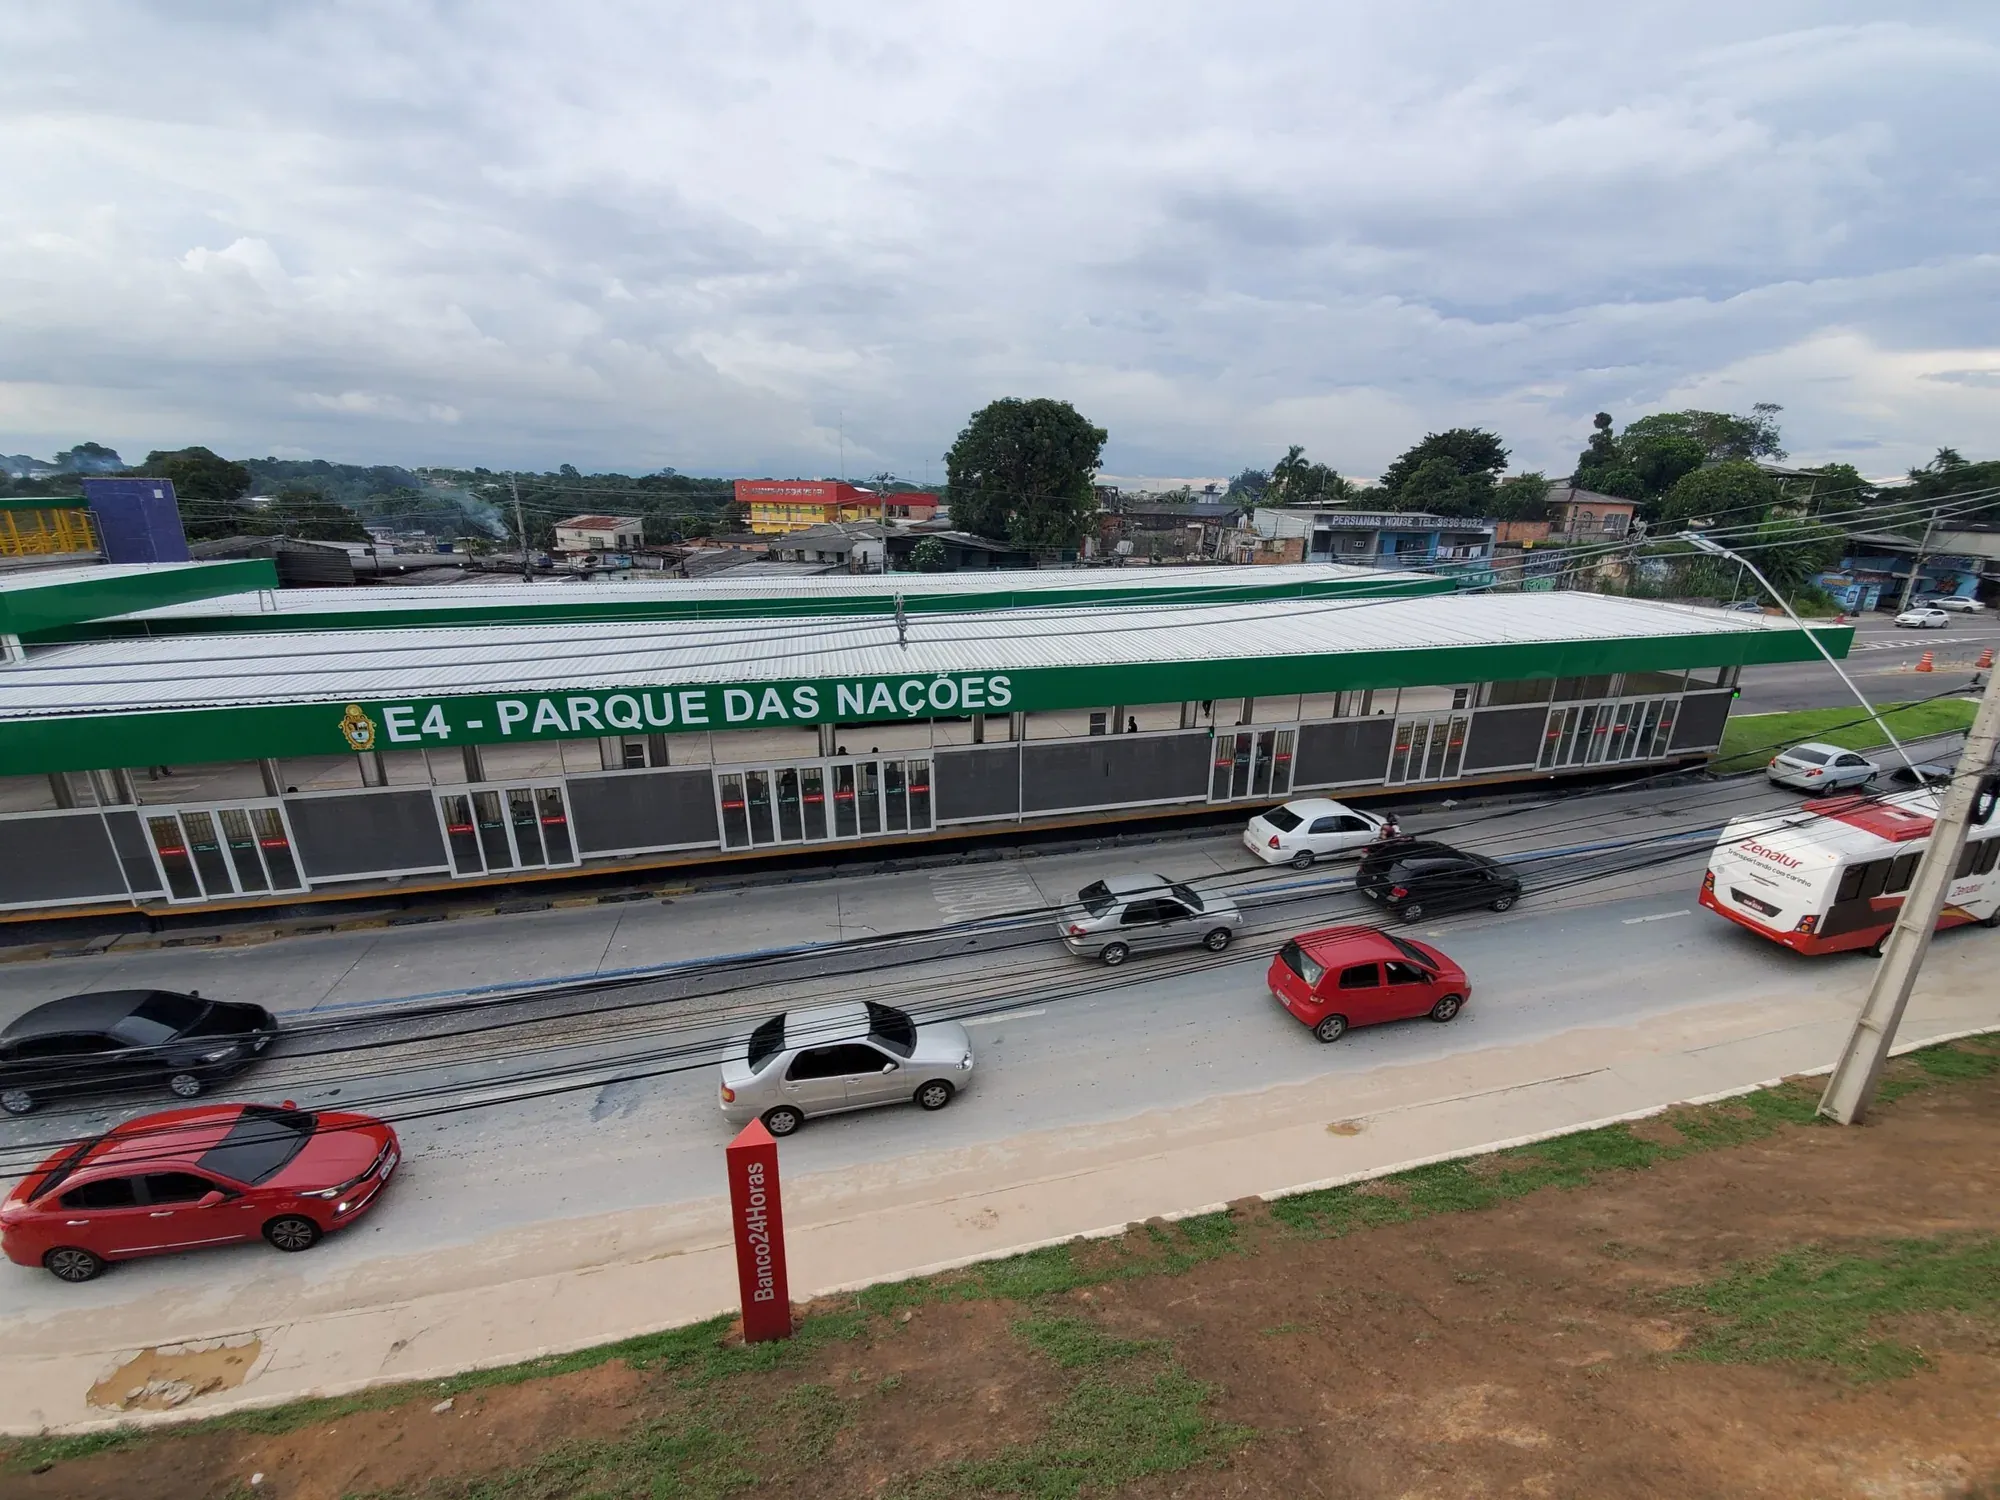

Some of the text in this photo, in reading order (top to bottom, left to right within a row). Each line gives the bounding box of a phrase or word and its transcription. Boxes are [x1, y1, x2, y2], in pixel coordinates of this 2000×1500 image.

[1332, 516, 1381, 526] PERSIANAS
[1385, 517, 1413, 527] HOUSE
[382, 673, 1012, 743] E4 - PARQUE DAS NAÇÕES
[1728, 848, 1771, 871] Transportando
[1772, 867, 1786, 877] com
[1786, 873, 1812, 887] carinho
[1740, 838, 1803, 869] Zenatur
[745, 1162, 775, 1302] Banco24Horas
